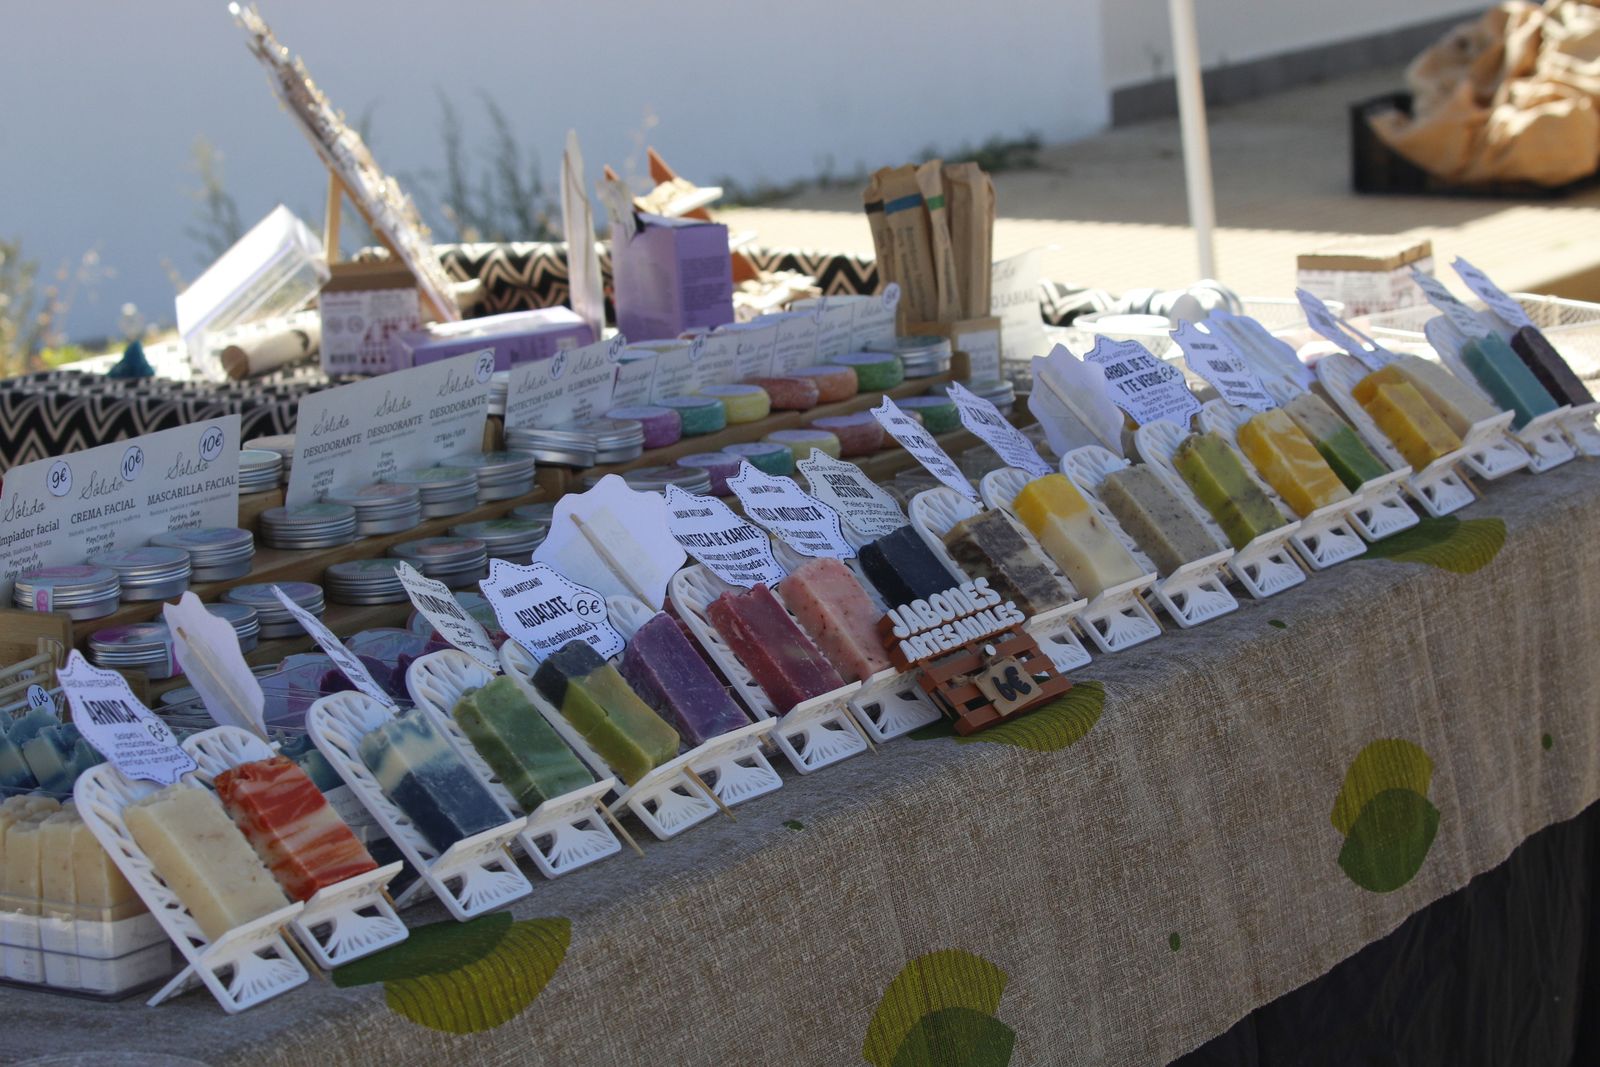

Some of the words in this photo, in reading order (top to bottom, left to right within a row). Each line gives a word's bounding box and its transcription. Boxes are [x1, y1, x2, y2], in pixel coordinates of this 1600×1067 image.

[477, 358, 494, 375] 7€
[1132, 357, 1144, 371] DE
[1140, 355, 1154, 368] TE
[1116, 381, 1129, 396] Y
[1126, 377, 1142, 393] TE
[1137, 370, 1166, 389] VERDE
[429, 394, 487, 420] DESODORANTE
[508, 393, 542, 414] ROTECTOR
[543, 387, 563, 402] SOLAR
[366, 414, 424, 440] DESODORANTE
[201, 432, 223, 454] 10€
[303, 432, 362, 459] DESODORANTE
[124, 449, 142, 477] 10€
[165, 452, 209, 480] Sólido
[52, 467, 67, 489] 9€
[79, 470, 124, 500] Sólido
[147, 483, 203, 506] MASCARILLA
[205, 475, 236, 492] FACIAL
[822, 472, 860, 487] CARBÓN
[830, 486, 874, 499] ACTIVADO
[2, 492, 46, 523] Sólido
[70, 507, 102, 524] CREMA
[104, 498, 136, 516] FACIAL
[752, 506, 779, 521] ROSA
[777, 505, 825, 522] MOSQUETA
[0, 527, 35, 547] impiador
[36, 518, 60, 535] facial
[673, 531, 716, 548] MANTECA
[710, 530, 727, 546] DE
[728, 547, 761, 560] hidratante
[736, 558, 765, 571] delicadas
[516, 577, 543, 595] ARTESANO
[411, 590, 466, 621] ROMERO
[514, 595, 574, 629] AGUACATE
[576, 600, 602, 616] 6€
[887, 576, 1001, 639] JABONES
[531, 638, 551, 650] Pieles
[547, 622, 593, 646] deshidratadas
[586, 634, 602, 646] con
[899, 600, 1026, 663] ARTESANALES
[80, 695, 142, 726] ÁRNICA
[147, 721, 169, 743] 6€
[158, 745, 175, 755] con
